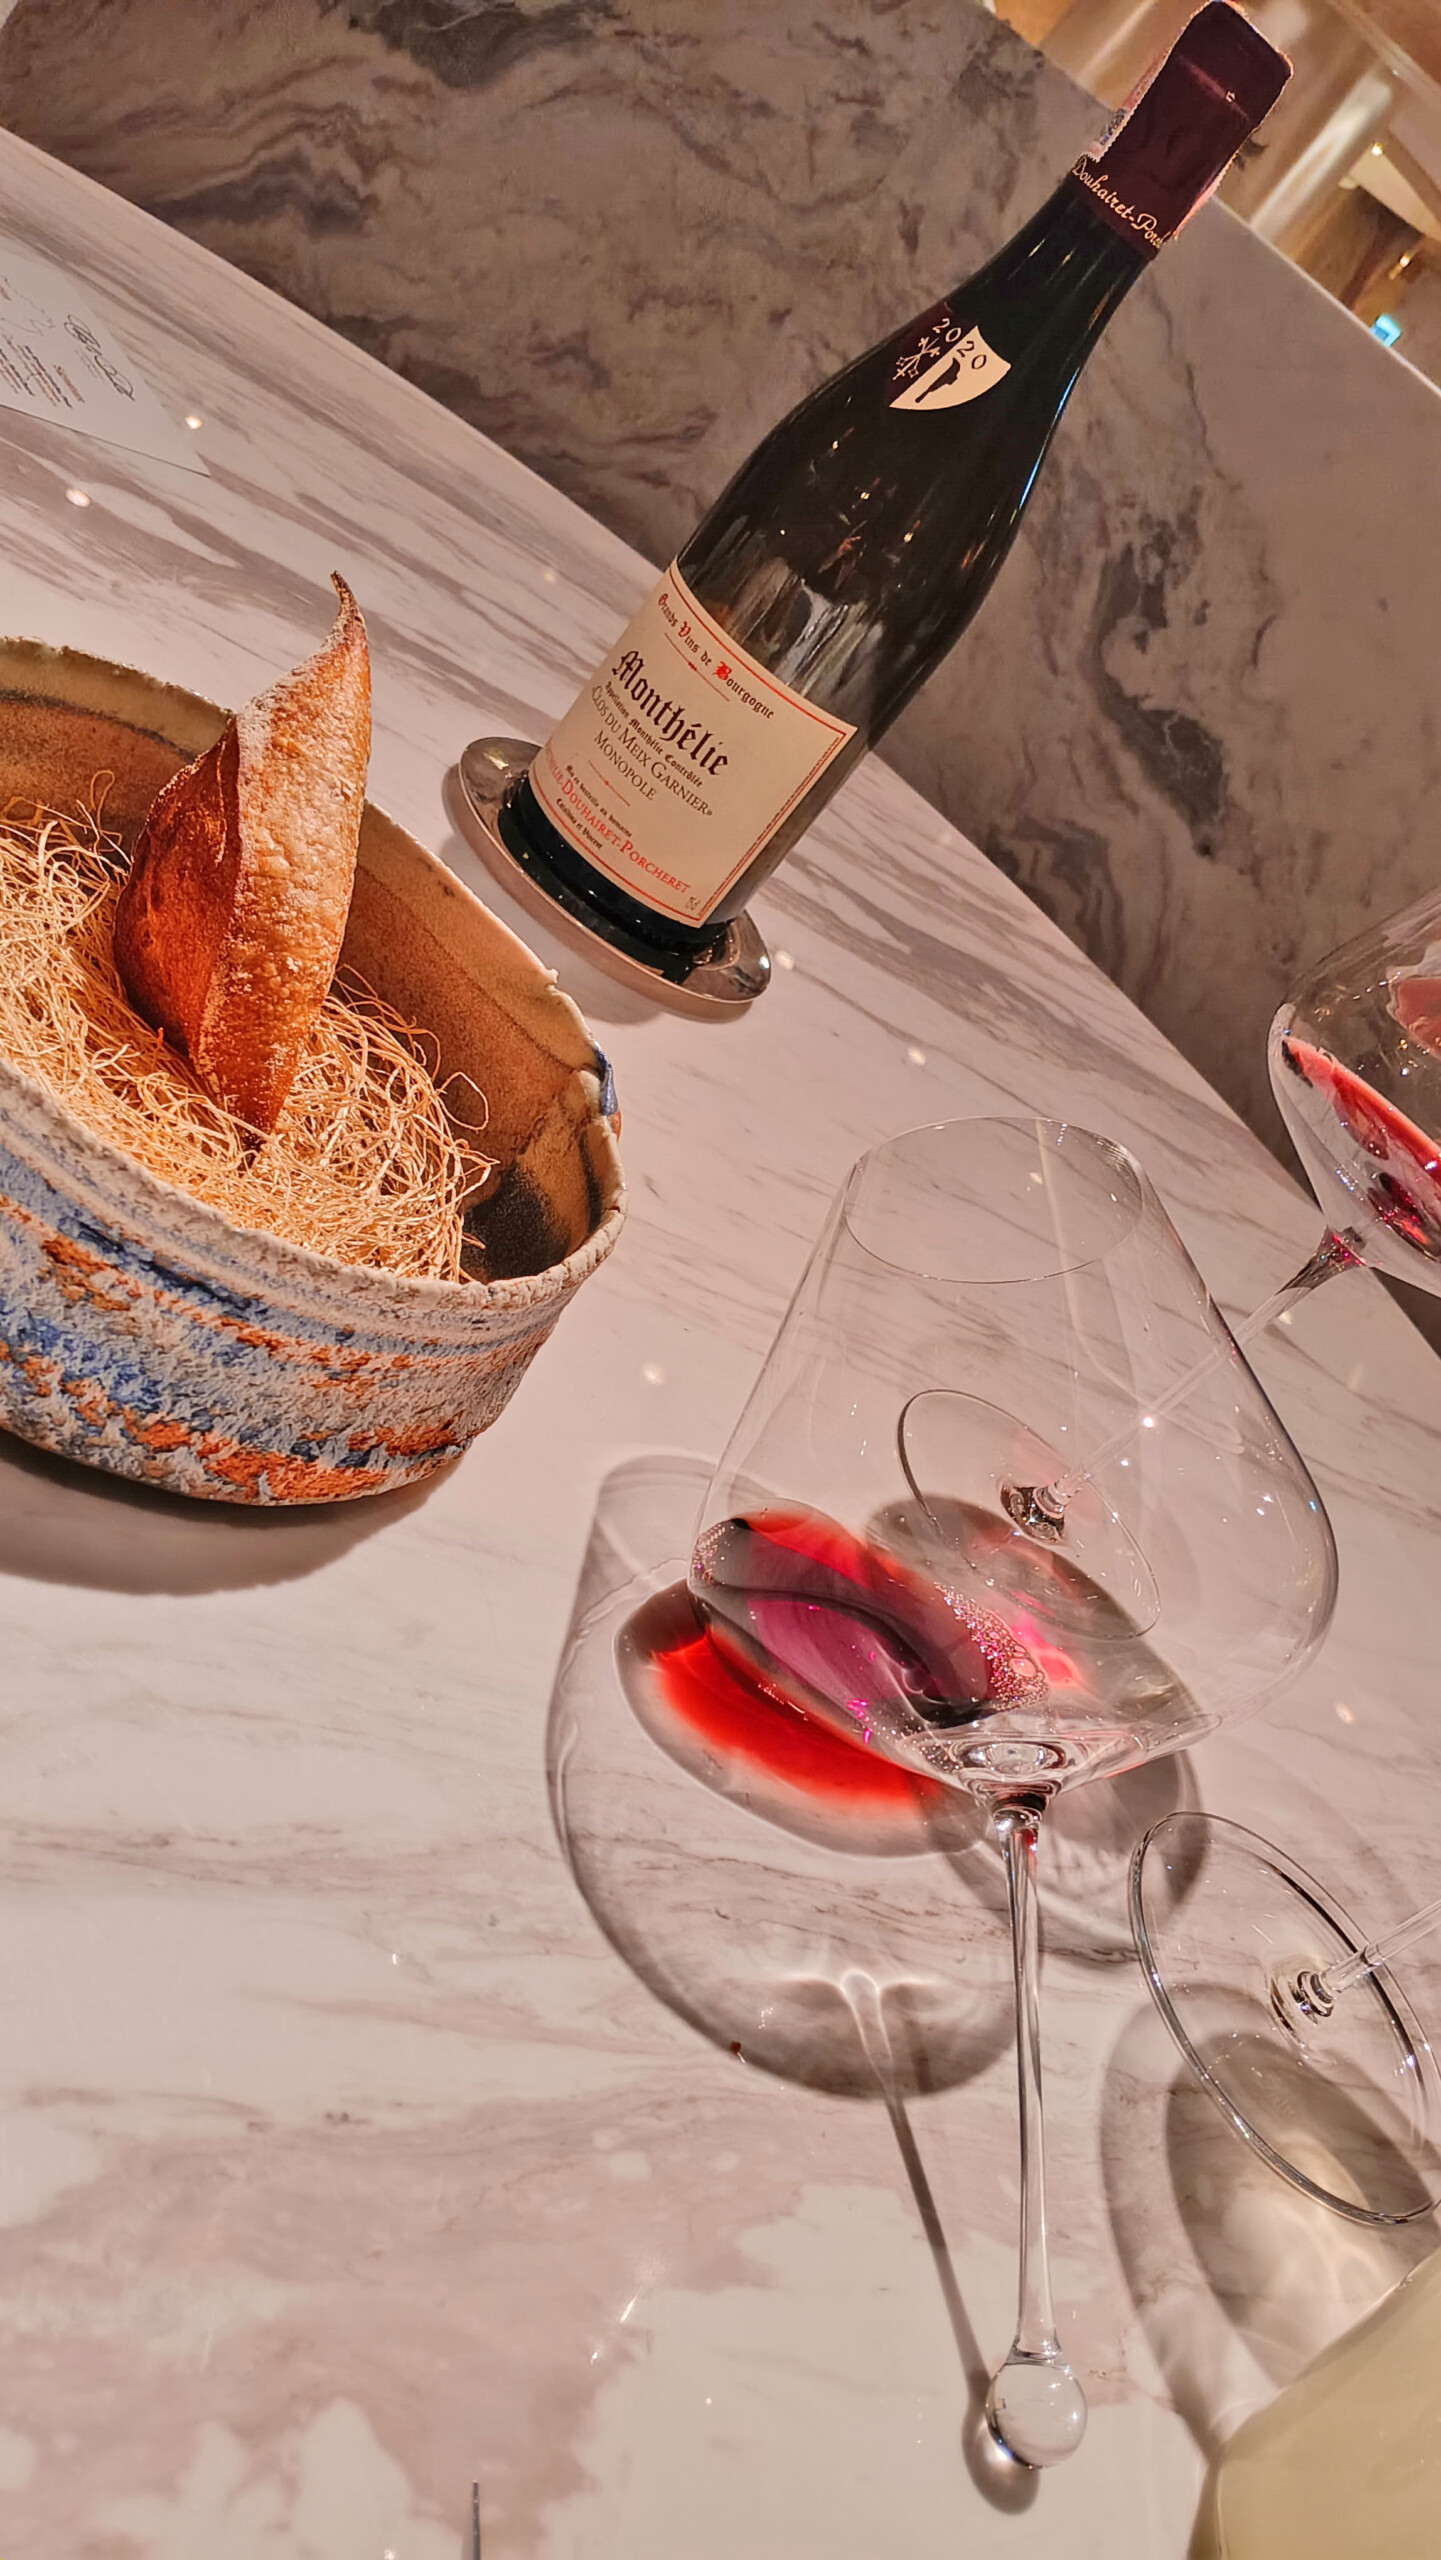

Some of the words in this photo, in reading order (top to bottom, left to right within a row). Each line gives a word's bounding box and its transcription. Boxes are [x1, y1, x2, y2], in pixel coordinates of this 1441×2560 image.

[932, 317, 987, 370] 2020
[658, 593, 678, 627] Grands
[678, 621, 699, 653] Vins
[700, 651, 712, 666] de
[712, 661, 774, 719] Bourgogne
[604, 712, 621, 733] DU
[618, 727, 652, 768] MEIX
[611, 651, 728, 776] Monthélie
[593, 729, 658, 801] MONOPOLE
